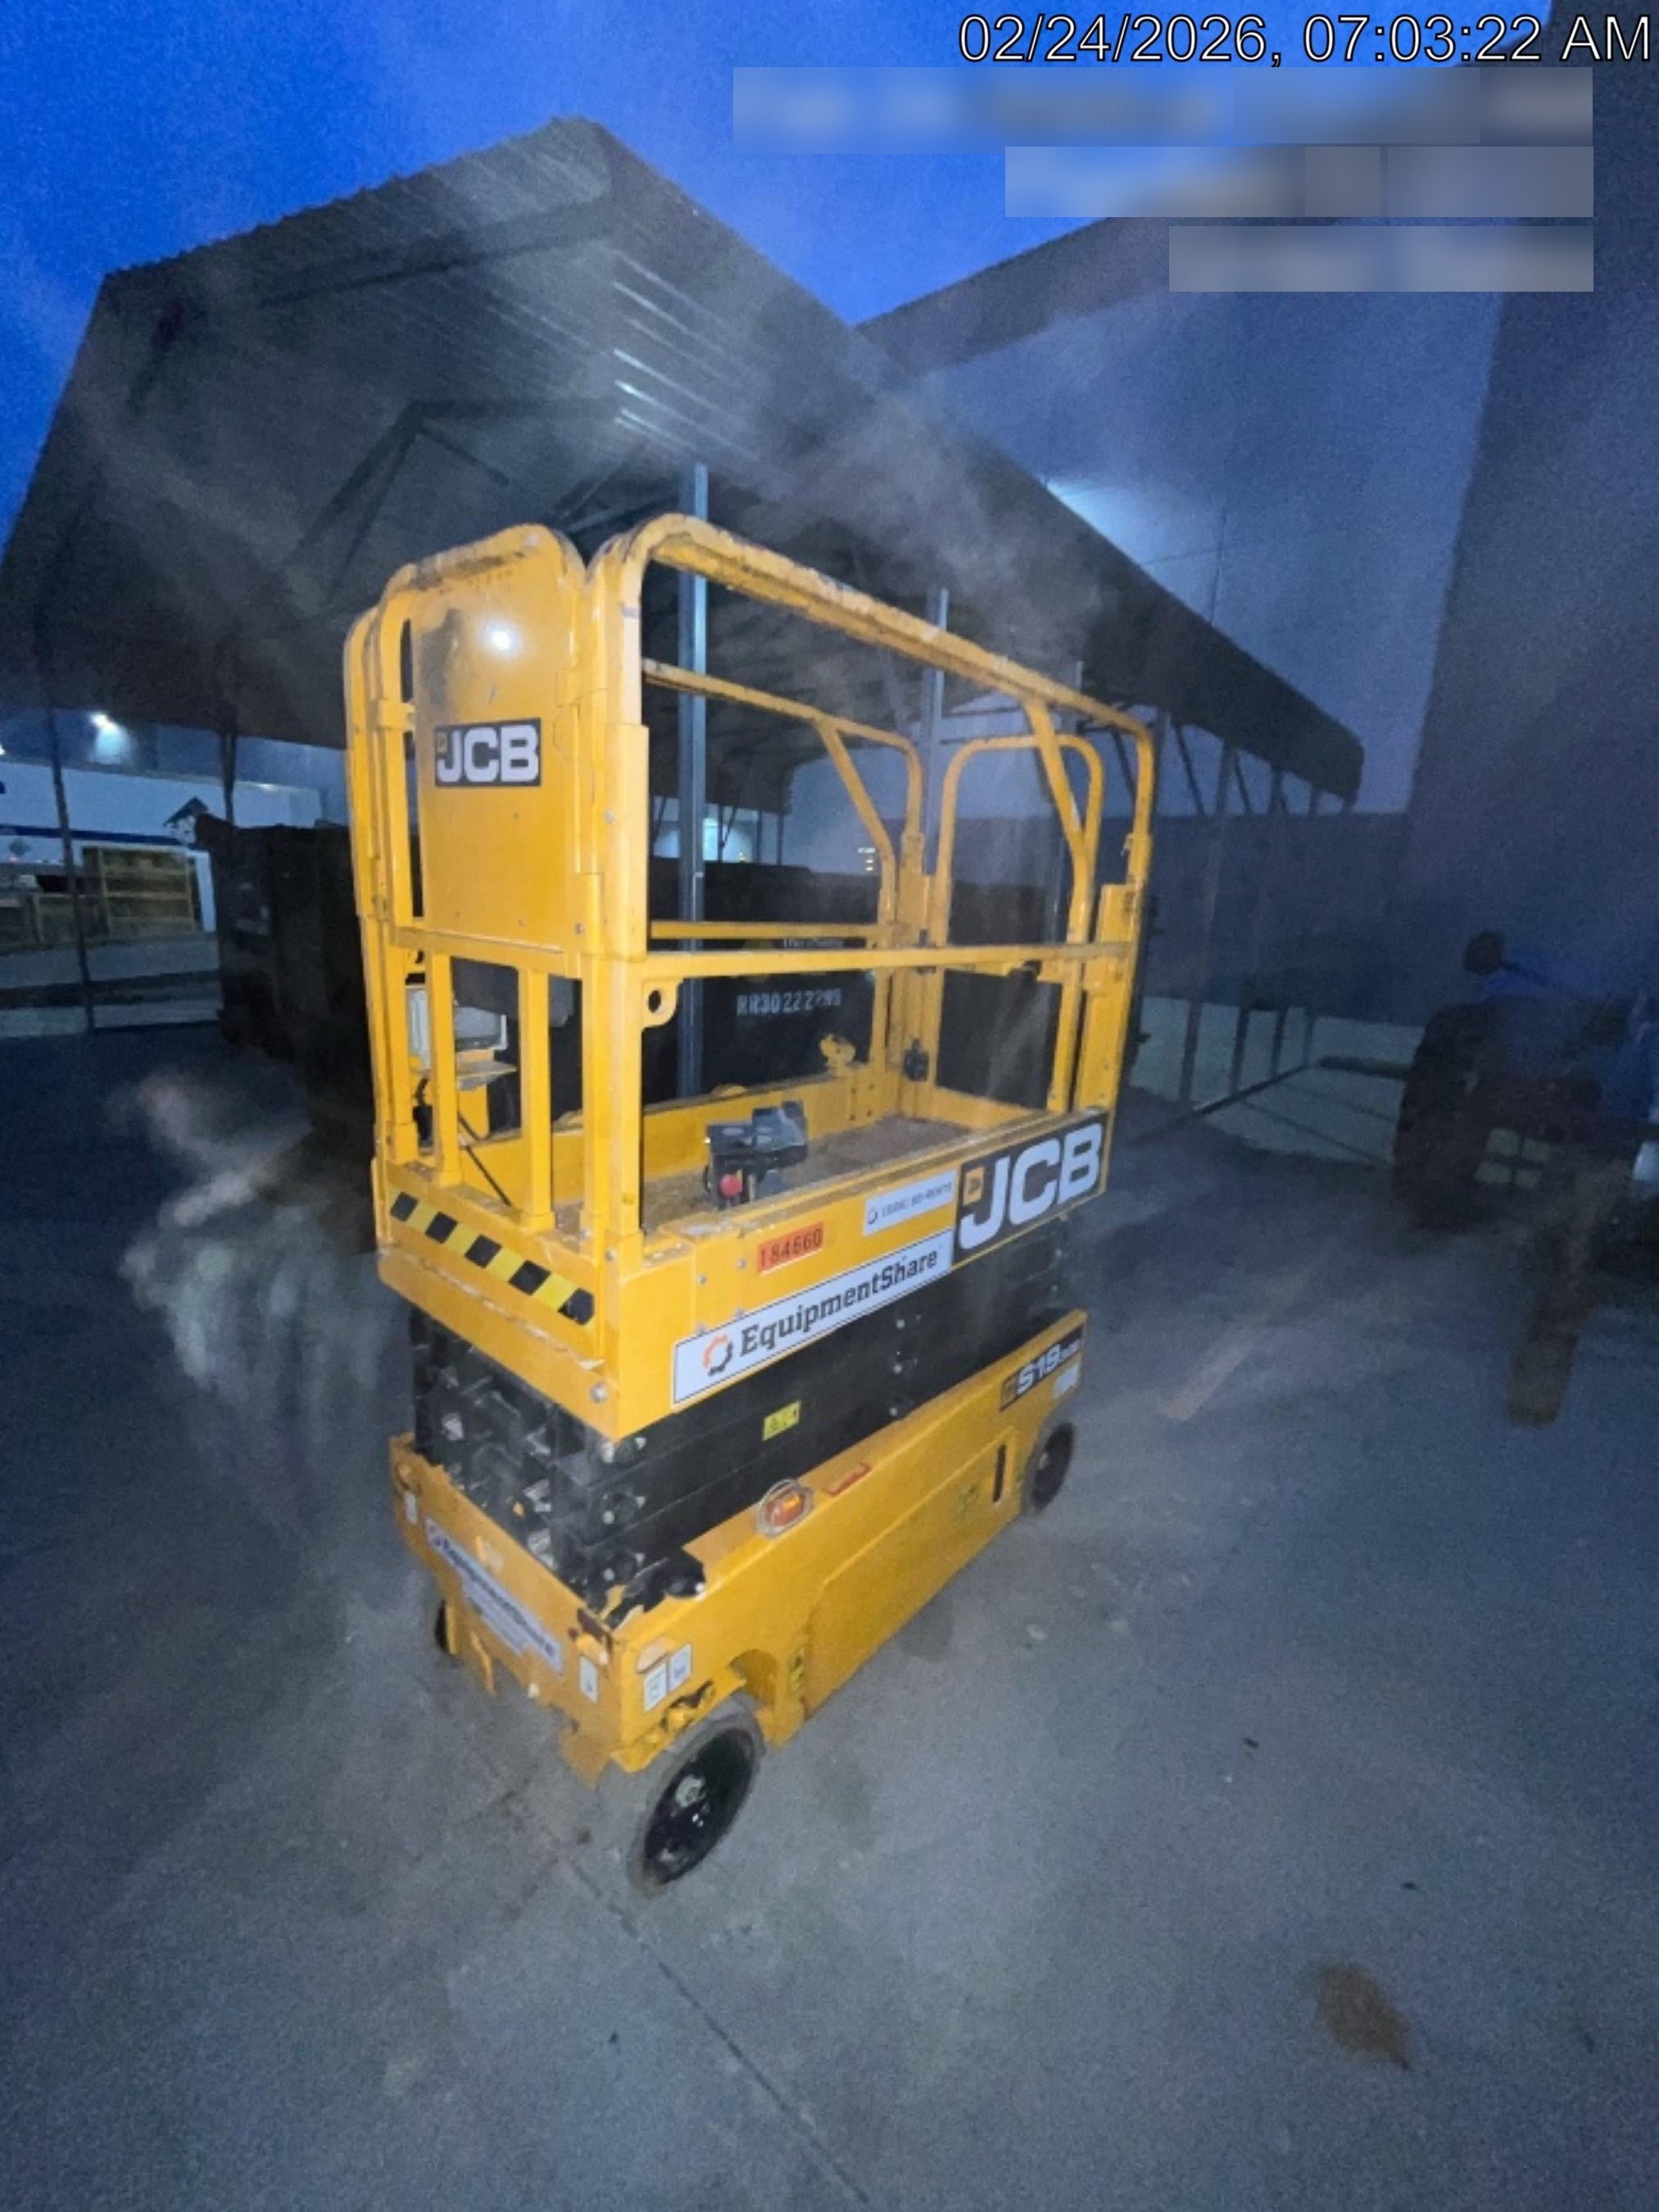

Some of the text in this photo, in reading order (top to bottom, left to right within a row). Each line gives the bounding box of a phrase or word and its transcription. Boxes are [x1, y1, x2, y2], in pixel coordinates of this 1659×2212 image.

[437, 724, 538, 782] JCB
[959, 1122, 1103, 1250] JCB
[760, 1228, 823, 1266] 184660
[740, 1250, 937, 1357] EquipmentShare
